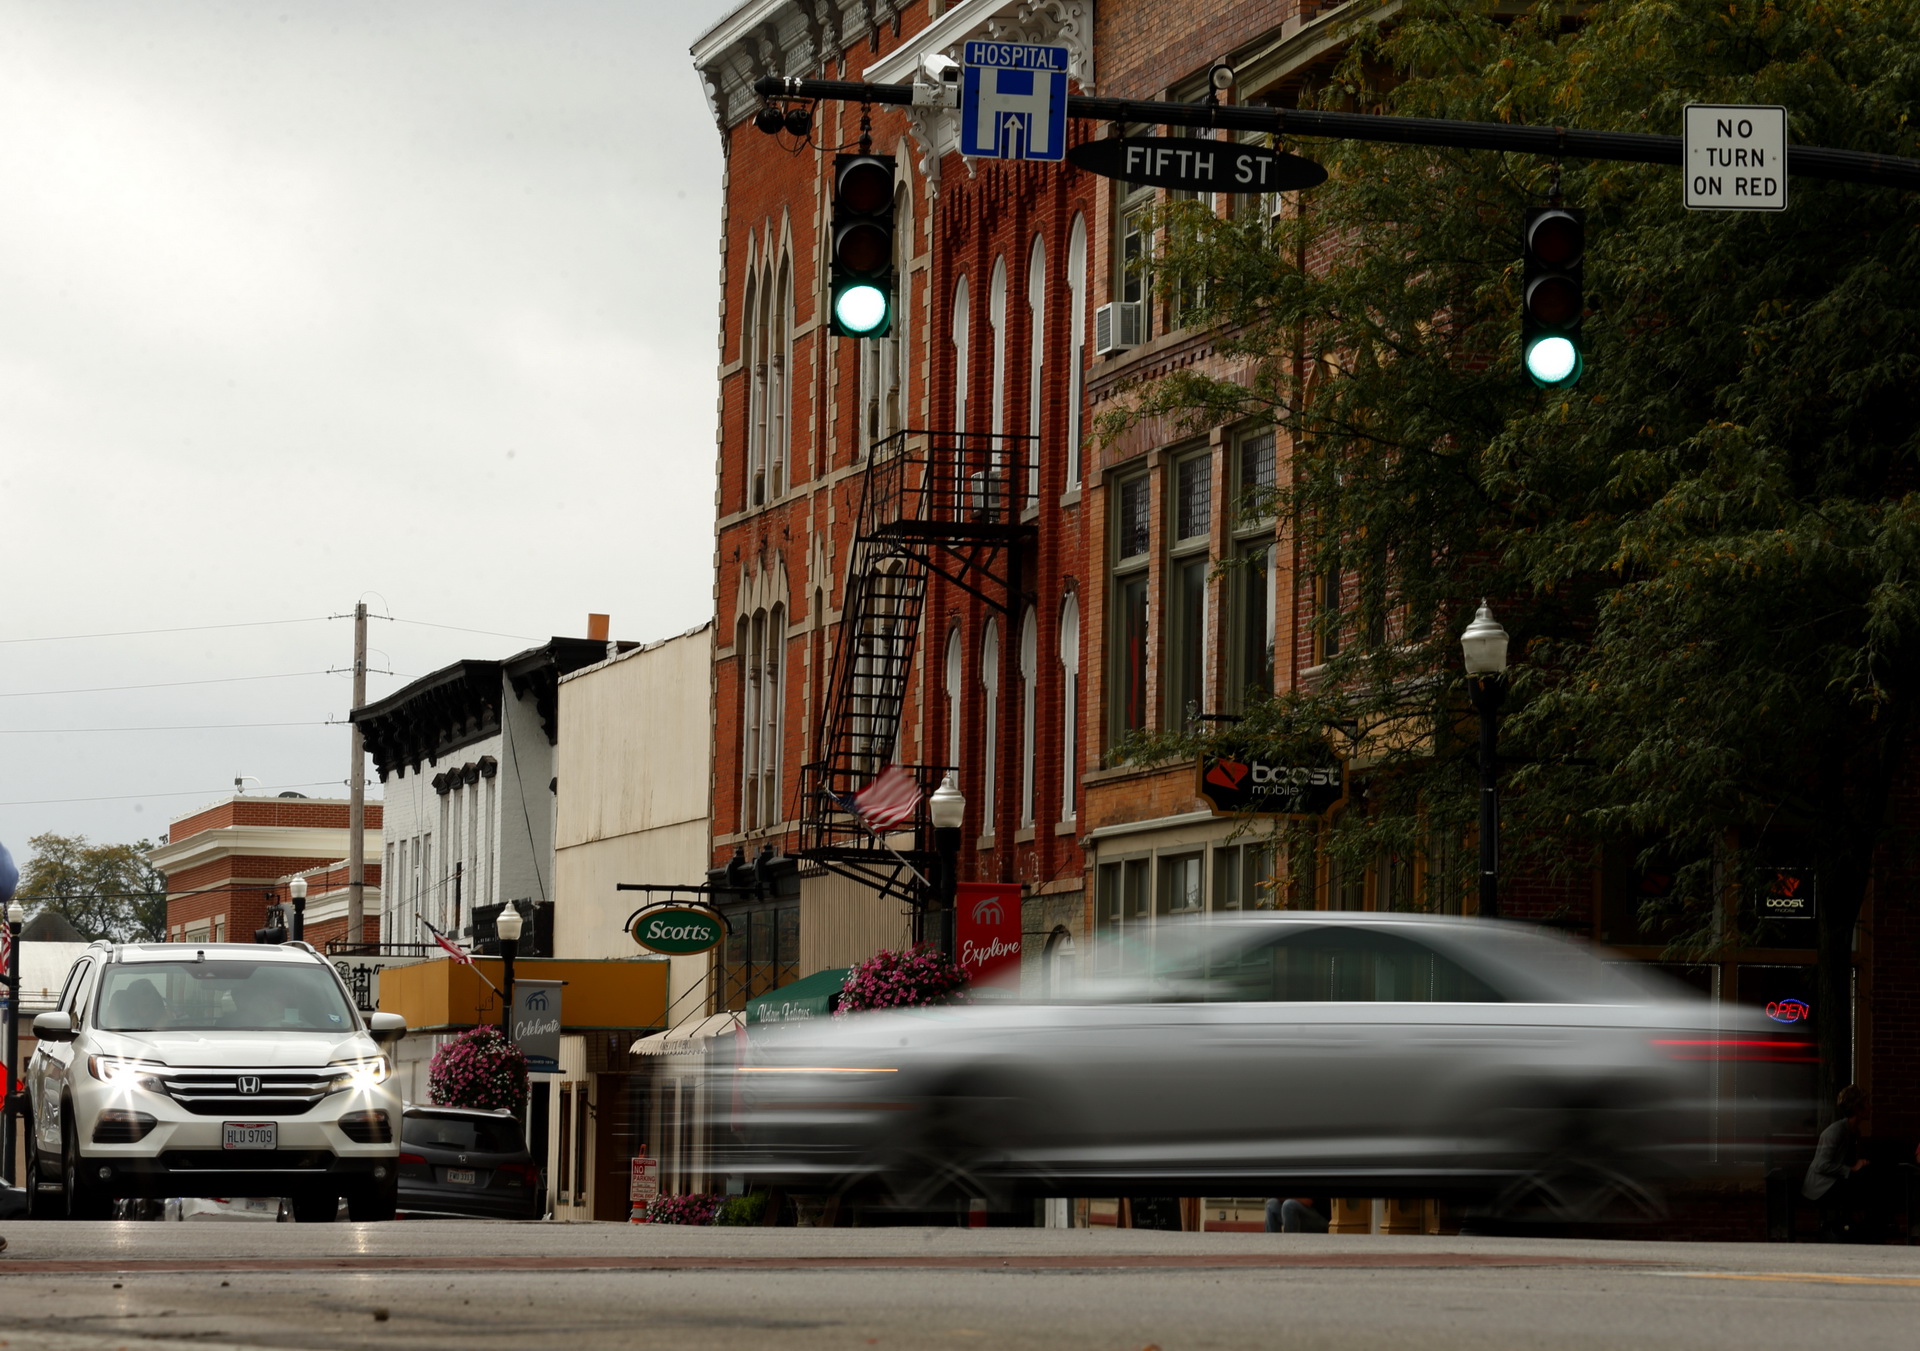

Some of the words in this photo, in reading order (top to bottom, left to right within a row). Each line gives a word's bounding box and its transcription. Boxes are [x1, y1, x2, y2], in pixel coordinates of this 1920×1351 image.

[973, 43, 1059, 69] HOSPITAL
[1717, 119, 1753, 138] NO
[1126, 146, 1214, 180] FIFTH
[1234, 154, 1273, 185] ST
[1706, 147, 1764, 167] TURN
[1693, 176, 1722, 195] ON
[1735, 177, 1777, 196] RED
[1252, 760, 1340, 786] boost
[1252, 785, 1299, 796] mobile
[1766, 897, 1805, 908] boost
[646, 920, 711, 941] Scotts
[962, 937, 1020, 967] Explore
[1765, 1001, 1810, 1020] OPEN
[515, 1018, 560, 1041] Celebrate
[227, 1130, 246, 1143] HLU
[248, 1130, 272, 1143] 9709
[634, 1165, 643, 1174] NO
